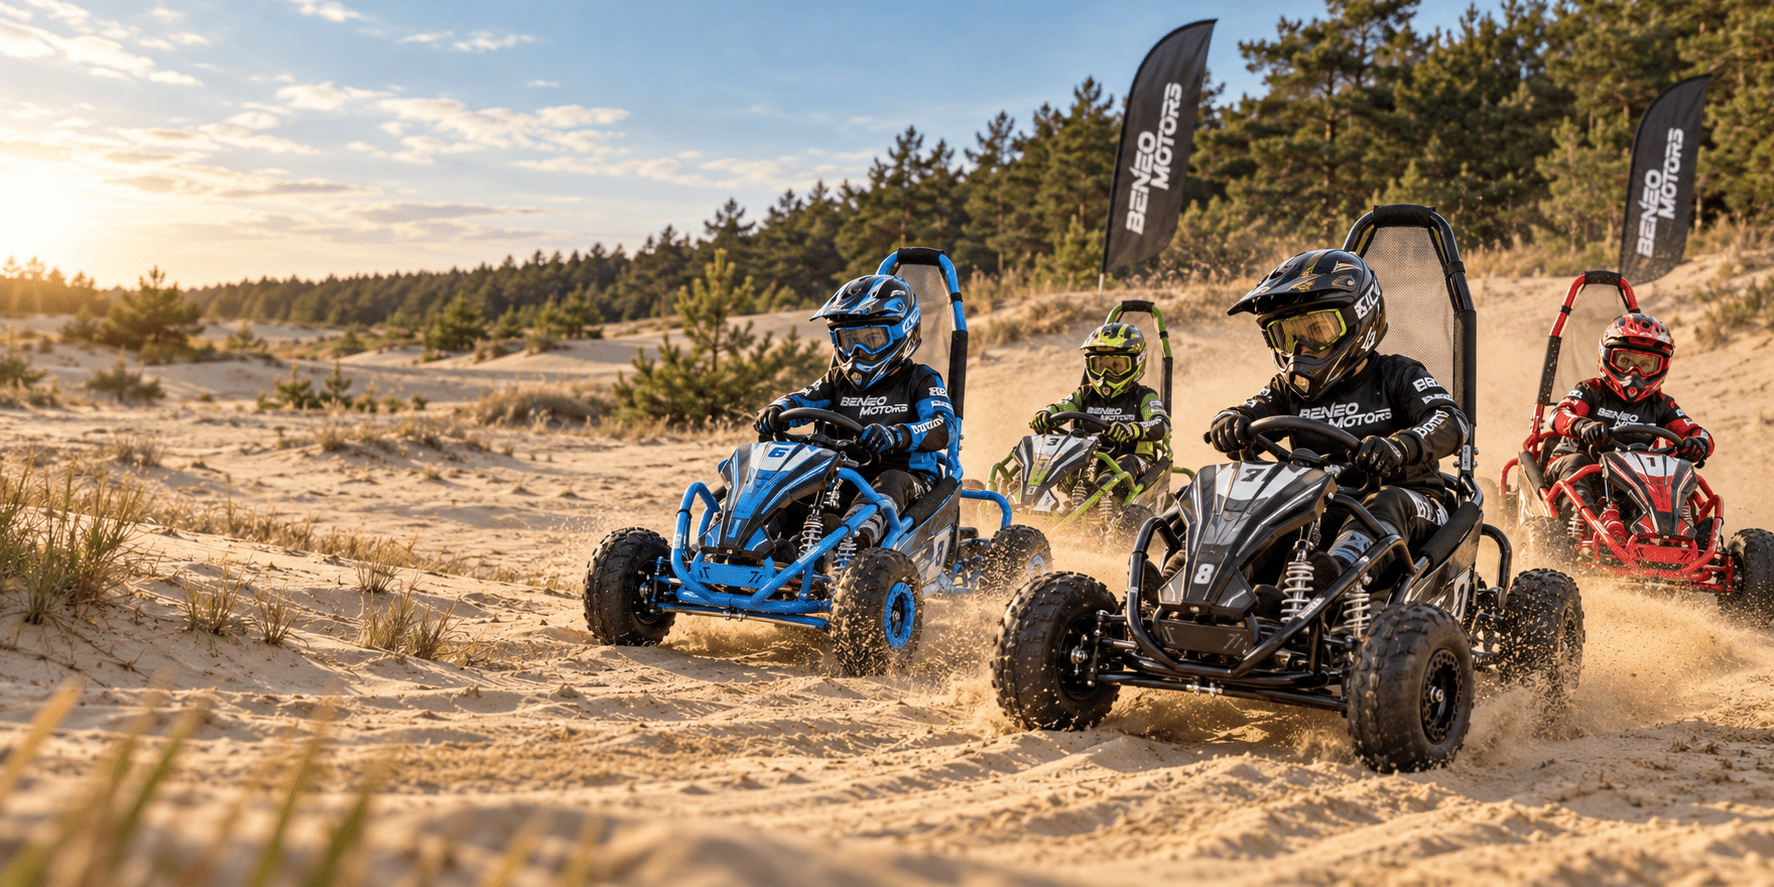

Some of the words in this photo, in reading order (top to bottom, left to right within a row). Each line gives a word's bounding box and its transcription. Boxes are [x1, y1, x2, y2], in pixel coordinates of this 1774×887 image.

[1150, 82, 1183, 191] MOTORS
[1125, 130, 1156, 236] BENEO
[1657, 127, 1684, 220] MOTORS
[1636, 169, 1662, 258] BENEO
[840, 394, 887, 406] BENEO
[1328, 408, 1392, 428] MOTORS
[767, 447, 790, 458] 6
[1193, 563, 1215, 585] 8
